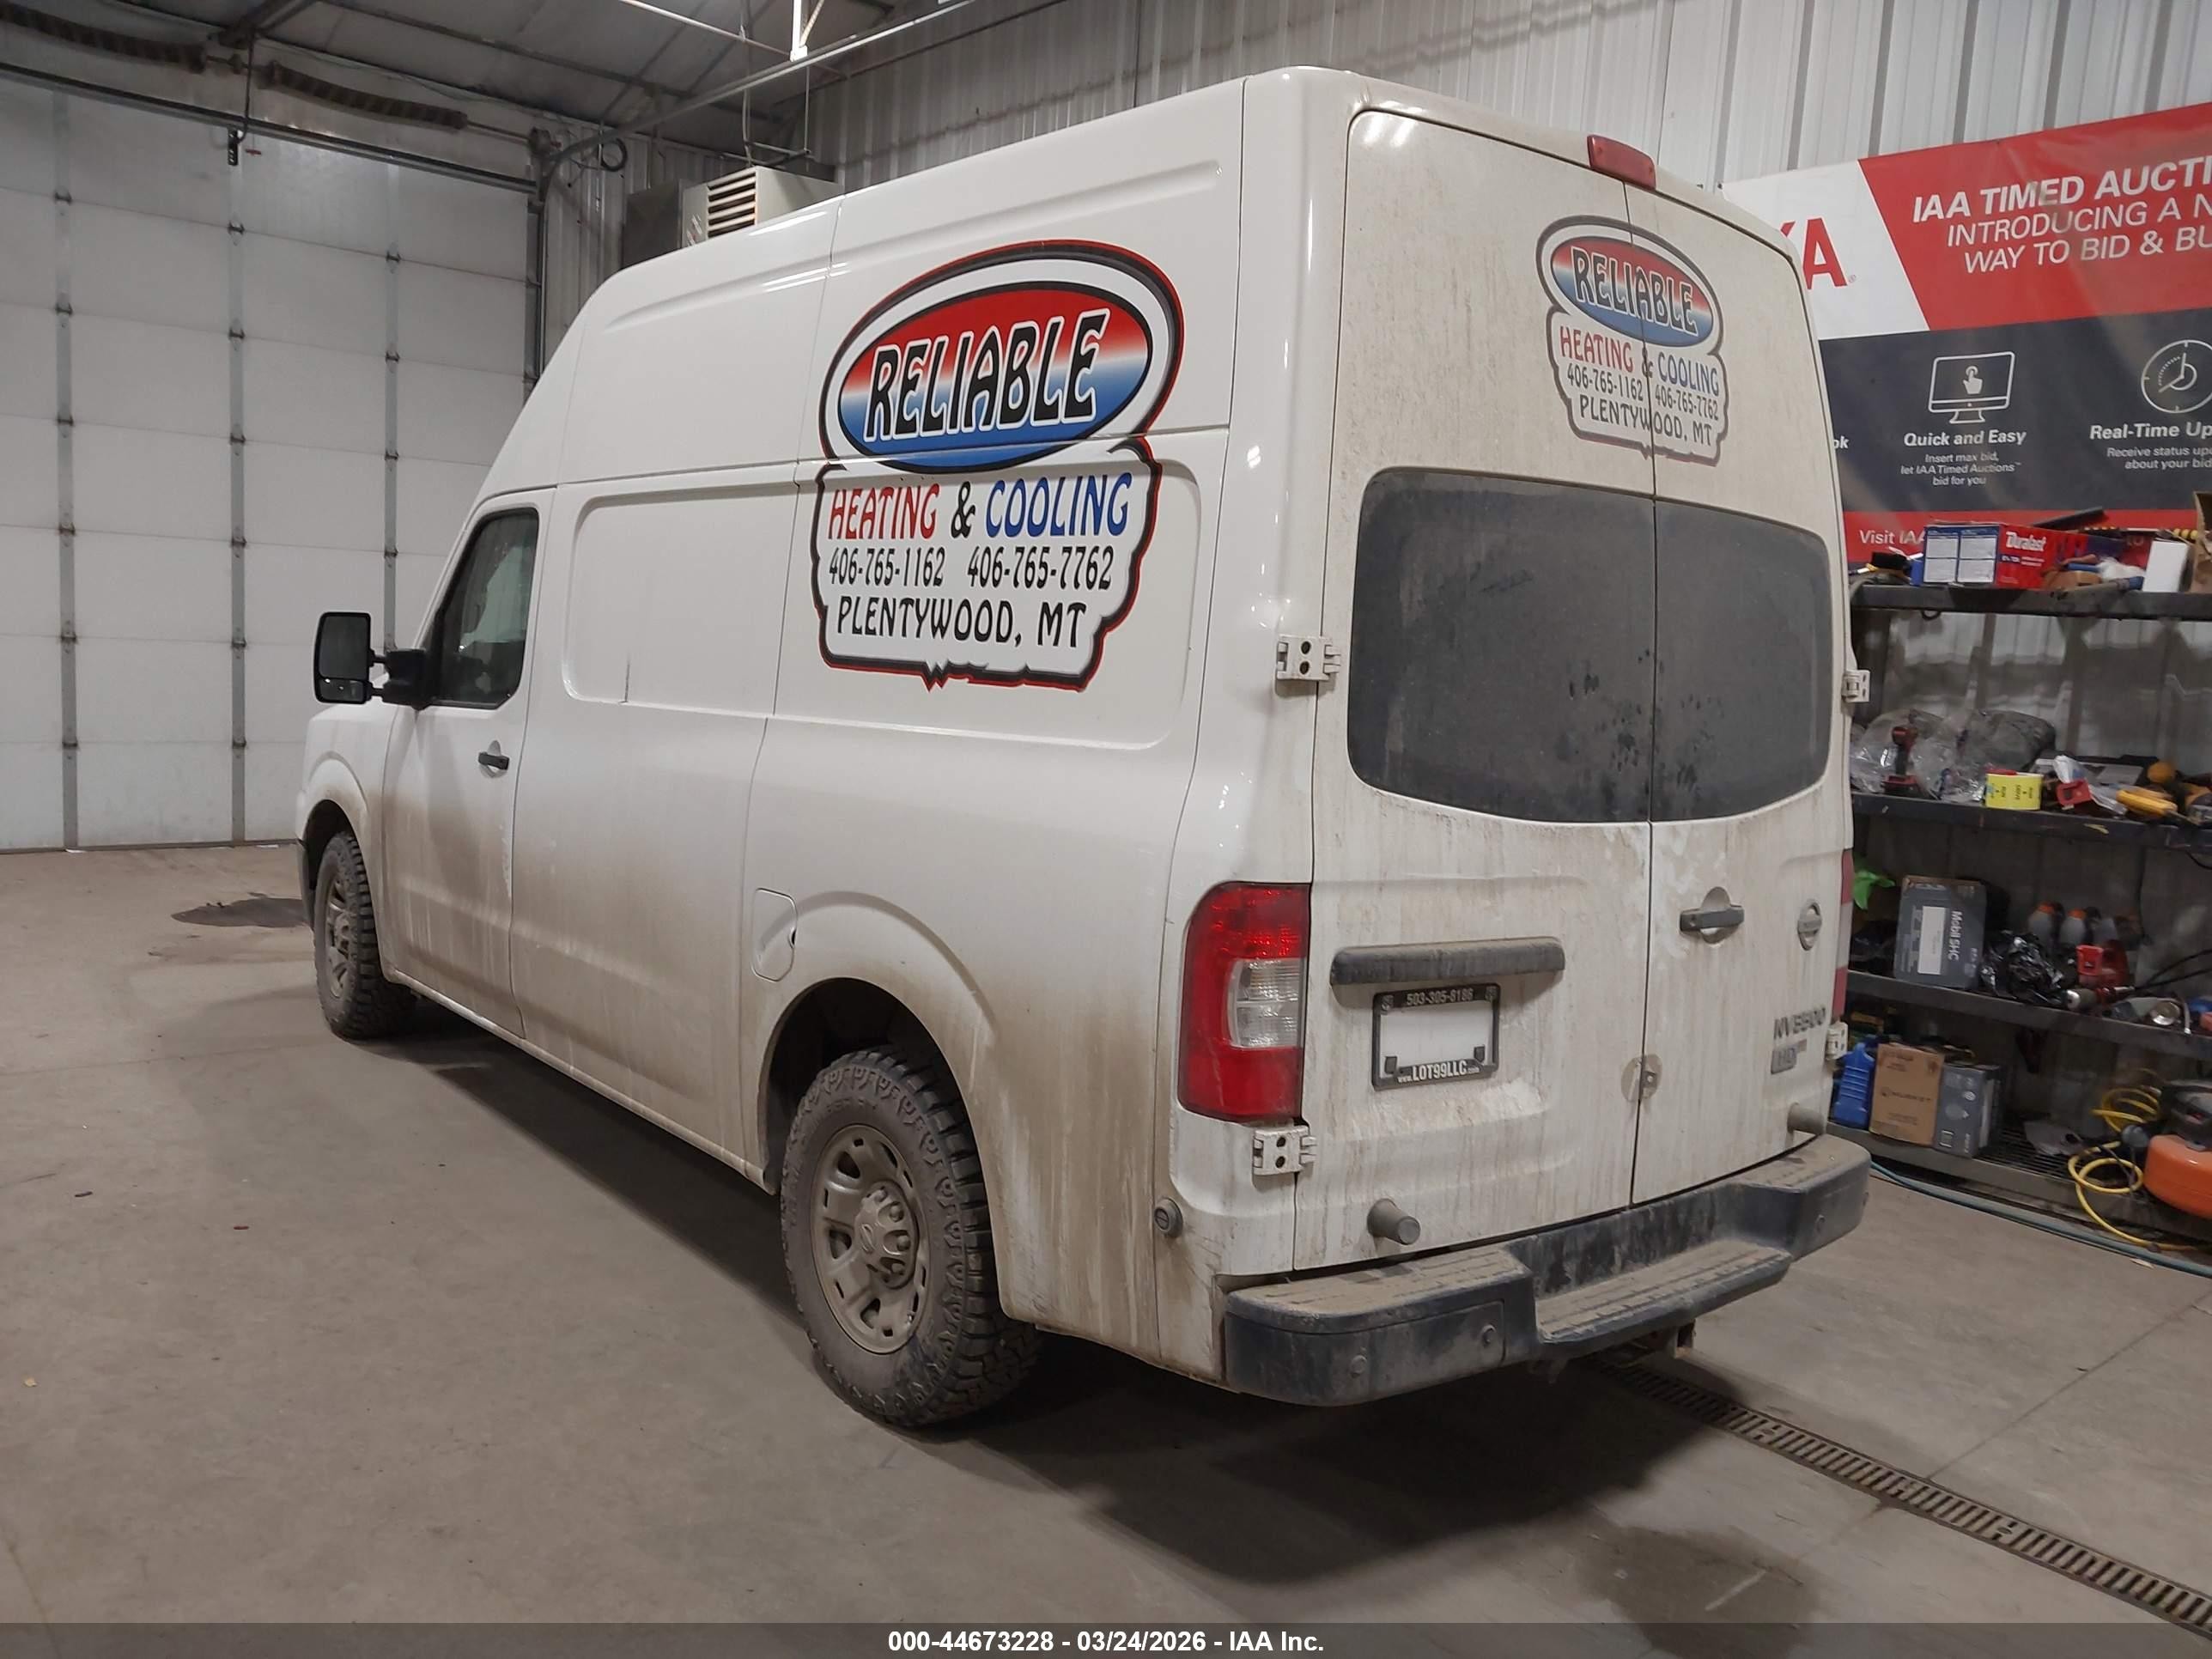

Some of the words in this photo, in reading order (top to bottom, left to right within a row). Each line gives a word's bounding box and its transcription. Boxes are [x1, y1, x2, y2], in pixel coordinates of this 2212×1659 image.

[1912, 191, 1972, 223] IAA
[1979, 176, 2085, 216] TIMED
[1947, 201, 2148, 247] INTRODUCING
[2156, 198, 2182, 223] A
[1964, 245, 2026, 274] WAY
[2033, 240, 2069, 266] TO
[2081, 234, 2130, 261] BID
[2139, 229, 2164, 256] &
[1571, 246, 1698, 337] RELIABLE
[863, 308, 1110, 443] RELIABLE
[1559, 325, 1633, 373] HEATING
[1641, 347, 1654, 379] &
[1657, 351, 1720, 397] COOLING
[1567, 362, 1644, 402] 406-765-1162
[1655, 384, 1719, 421] 406-765-7762
[1579, 394, 1688, 441] PLENTYWOOD,
[1692, 420, 1713, 447] MT
[1904, 432, 1950, 447] Quick
[1954, 430, 1984, 445] and
[1988, 429, 2027, 445] Easy
[2089, 422, 2180, 440] Real-Time
[2185, 421, 2212, 440] Up
[1900, 465, 1914, 475] let
[1916, 465, 1936, 475] IAA
[1937, 464, 1968, 474] Timed
[1924, 453, 1954, 463] Insert
[1955, 453, 1978, 462] max
[2106, 447, 2151, 457] Receive
[2153, 447, 2191, 457] status
[2124, 459, 2160, 470] about
[2161, 460, 2190, 470] your
[1932, 476, 1949, 486] bid
[1951, 476, 1966, 485] for
[1967, 477, 1986, 487] you
[828, 483, 940, 540] HEATING
[951, 480, 977, 539] &
[985, 471, 1133, 538] COOLING
[1860, 530, 1894, 544] Visit
[829, 546, 945, 587] 406-765-1162
[967, 545, 1115, 590] 406-765-7762
[836, 595, 1022, 647] PLENTYWOOD,
[1037, 600, 1087, 648] MT
[1949, 910, 1963, 939] Mobil
